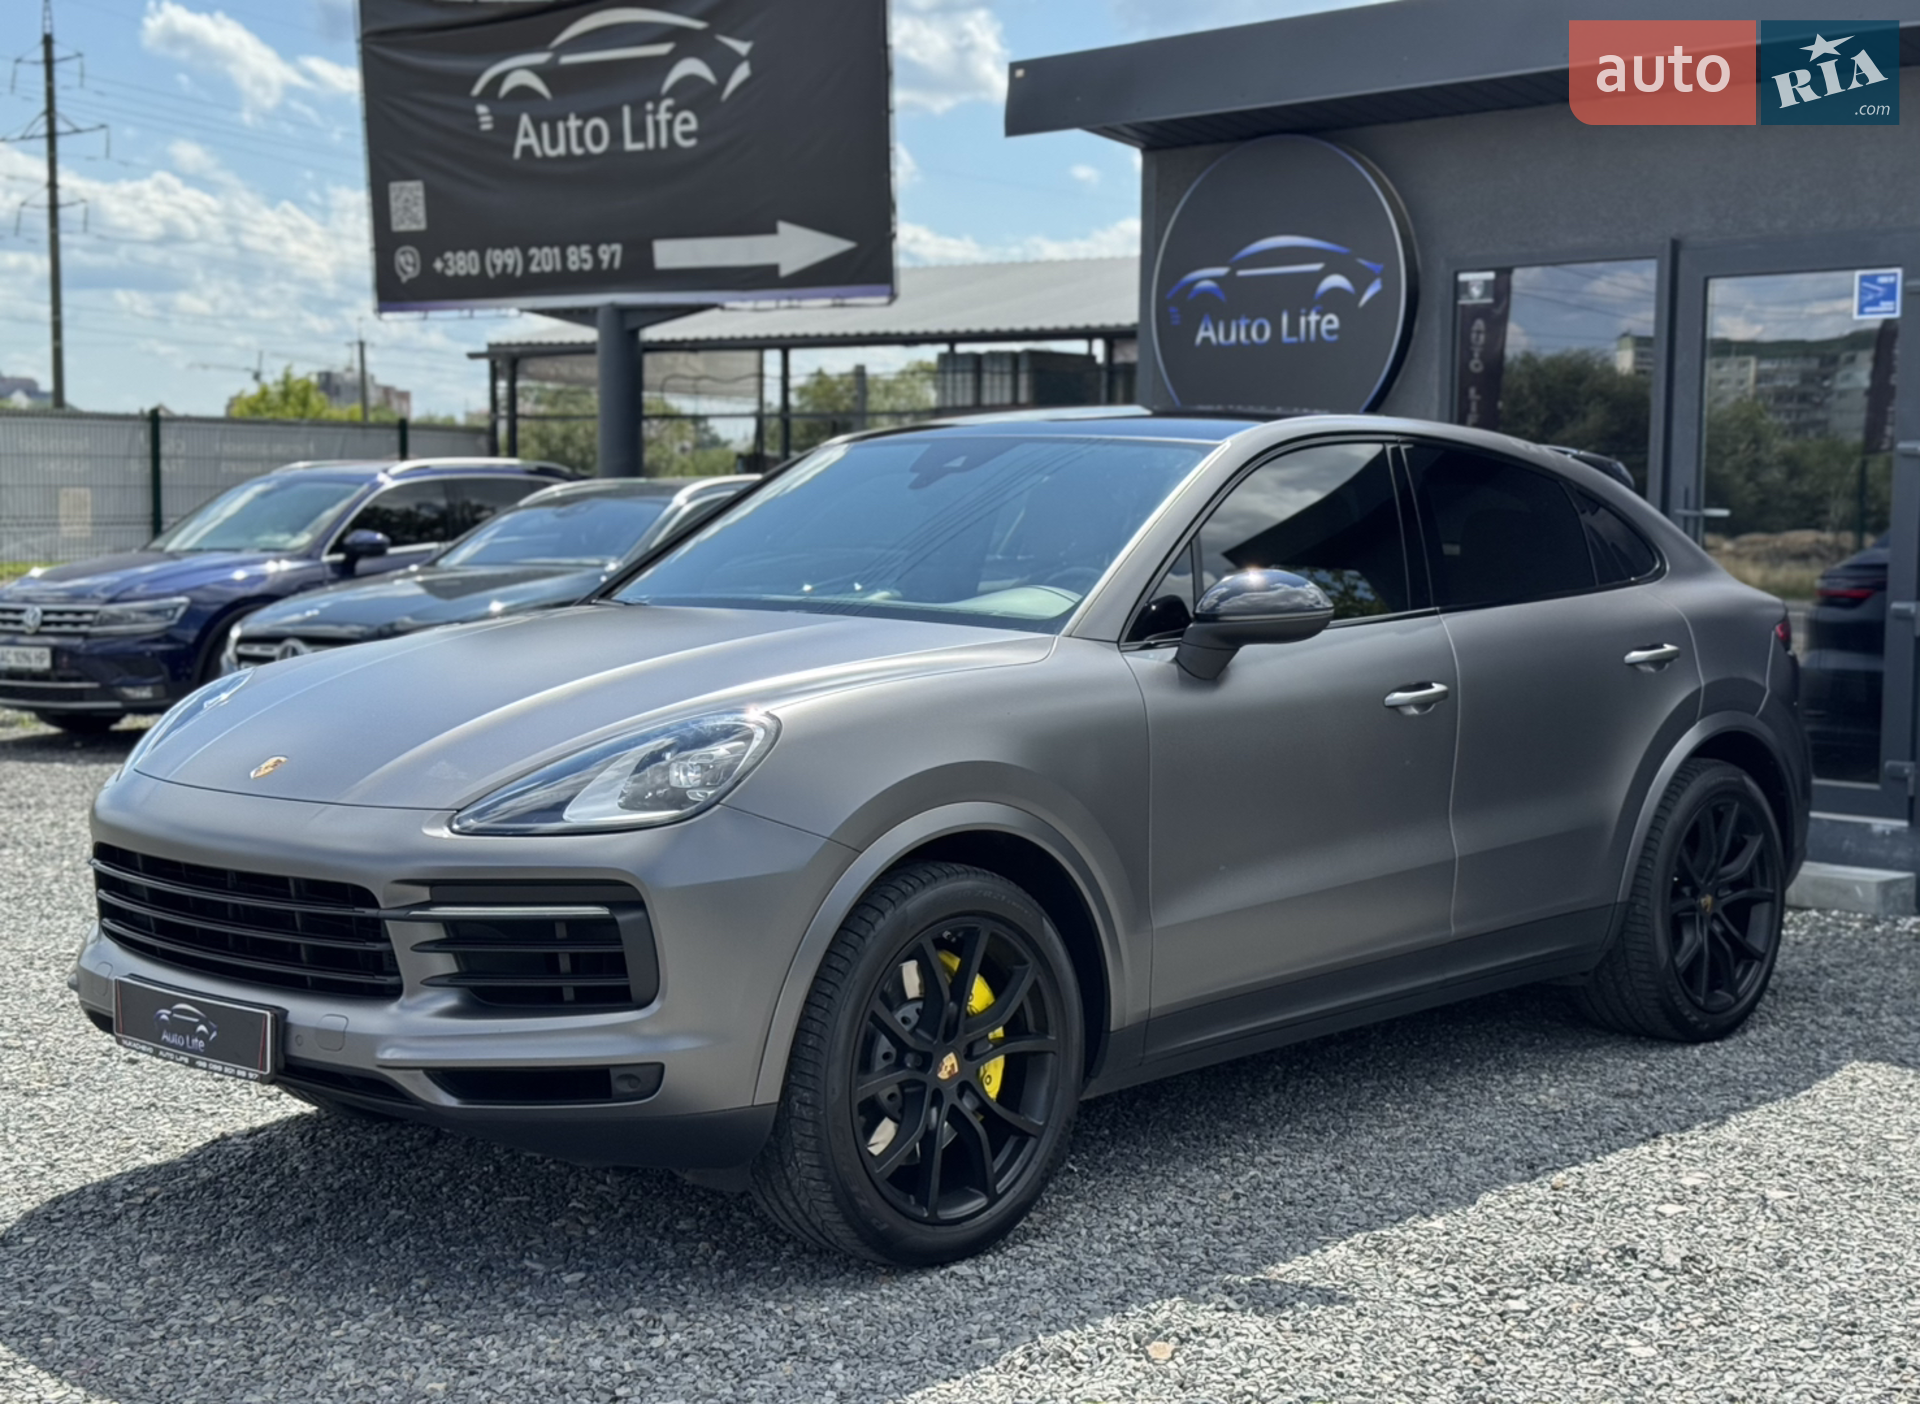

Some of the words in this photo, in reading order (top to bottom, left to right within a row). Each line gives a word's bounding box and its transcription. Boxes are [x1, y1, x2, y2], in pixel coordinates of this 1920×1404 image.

[513, 111, 610, 159] Auto
[622, 99, 699, 152] Life
[433, 249, 481, 277] +380
[484, 246, 524, 279] (99)
[528, 246, 562, 273] 201
[566, 244, 594, 272] 85
[598, 243, 623, 270] 97
[1194, 312, 1271, 347] Auto
[1280, 304, 1340, 344] Life
[161, 1029, 185, 1047] Auto
[186, 1034, 206, 1052] Life
